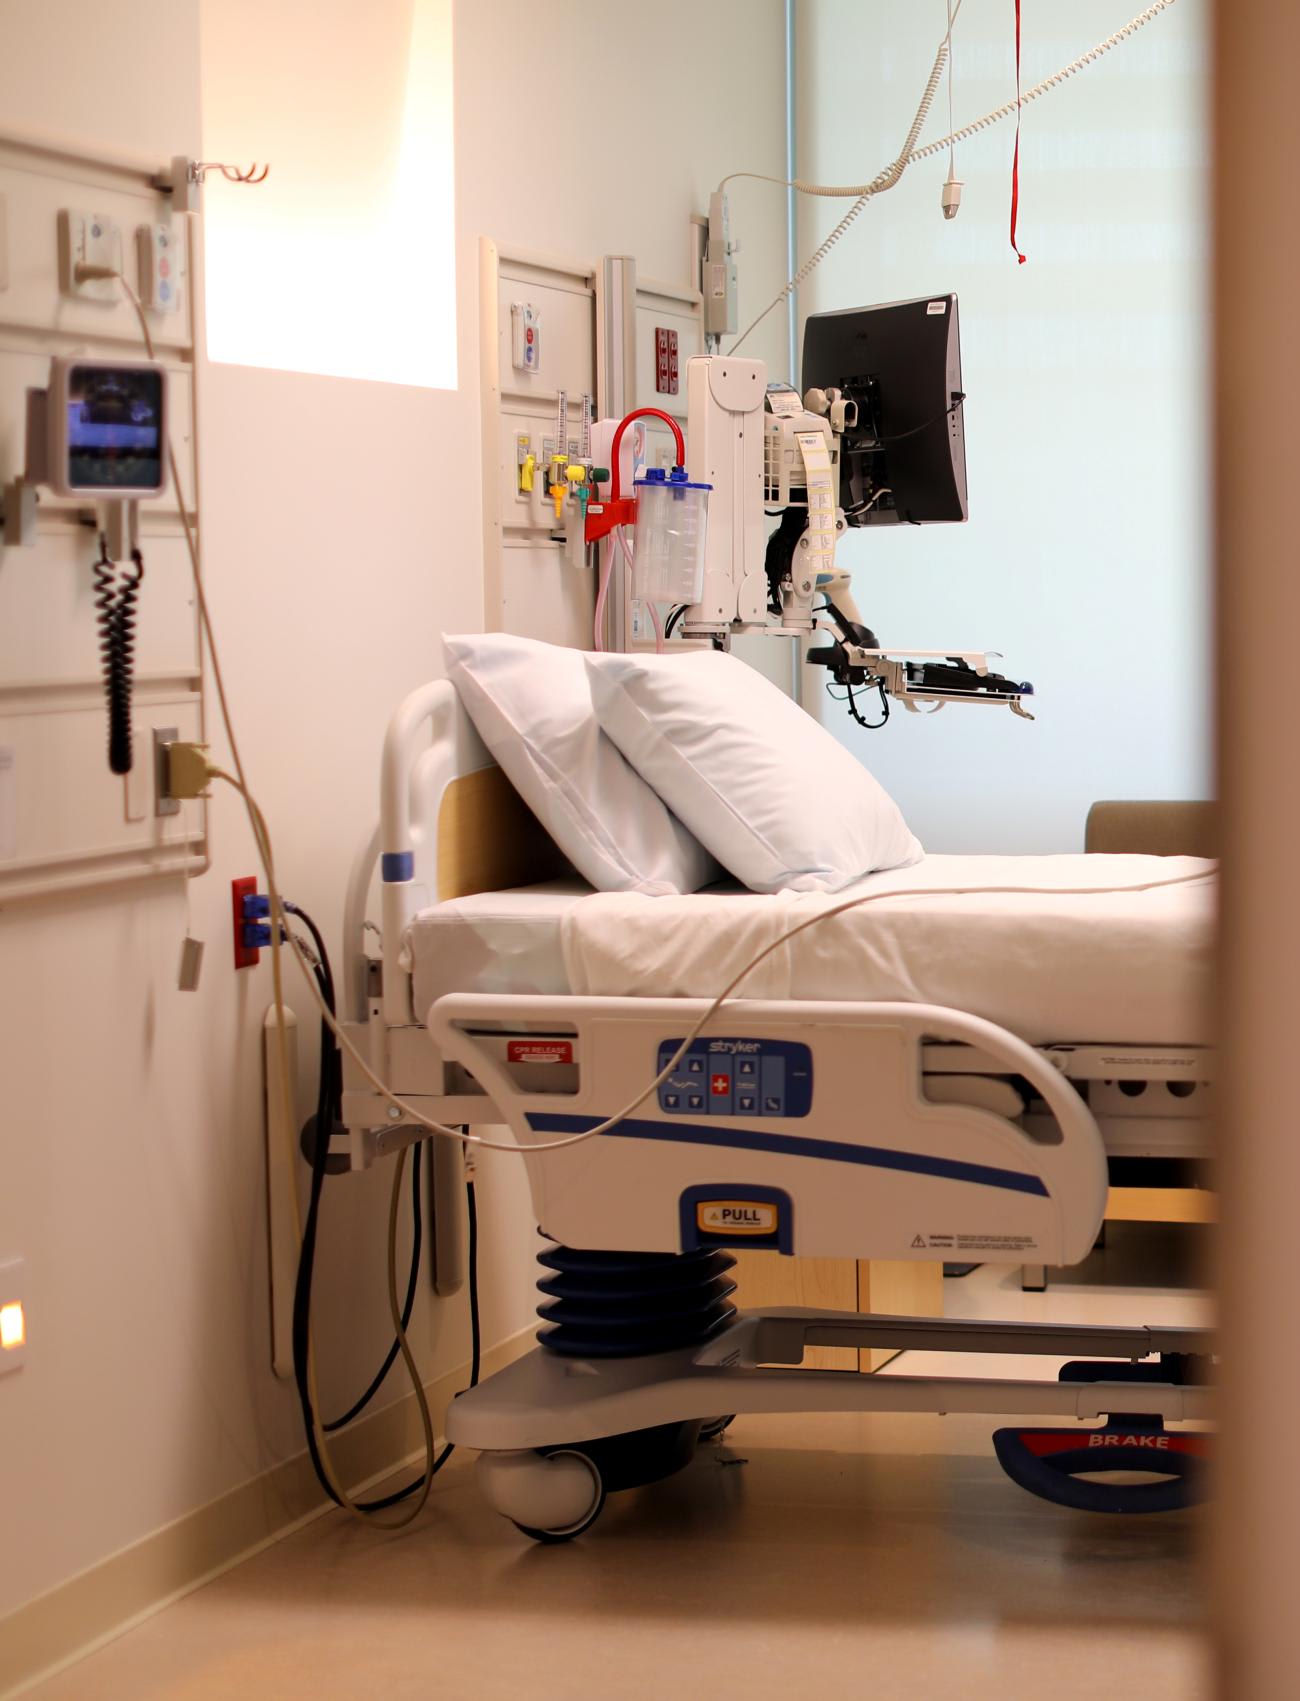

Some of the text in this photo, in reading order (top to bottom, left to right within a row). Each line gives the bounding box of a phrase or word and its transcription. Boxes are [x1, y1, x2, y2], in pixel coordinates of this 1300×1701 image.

[709, 1040, 760, 1054] stryker
[722, 1208, 760, 1221] PULL
[1088, 1434, 1169, 1449] BRAKE
